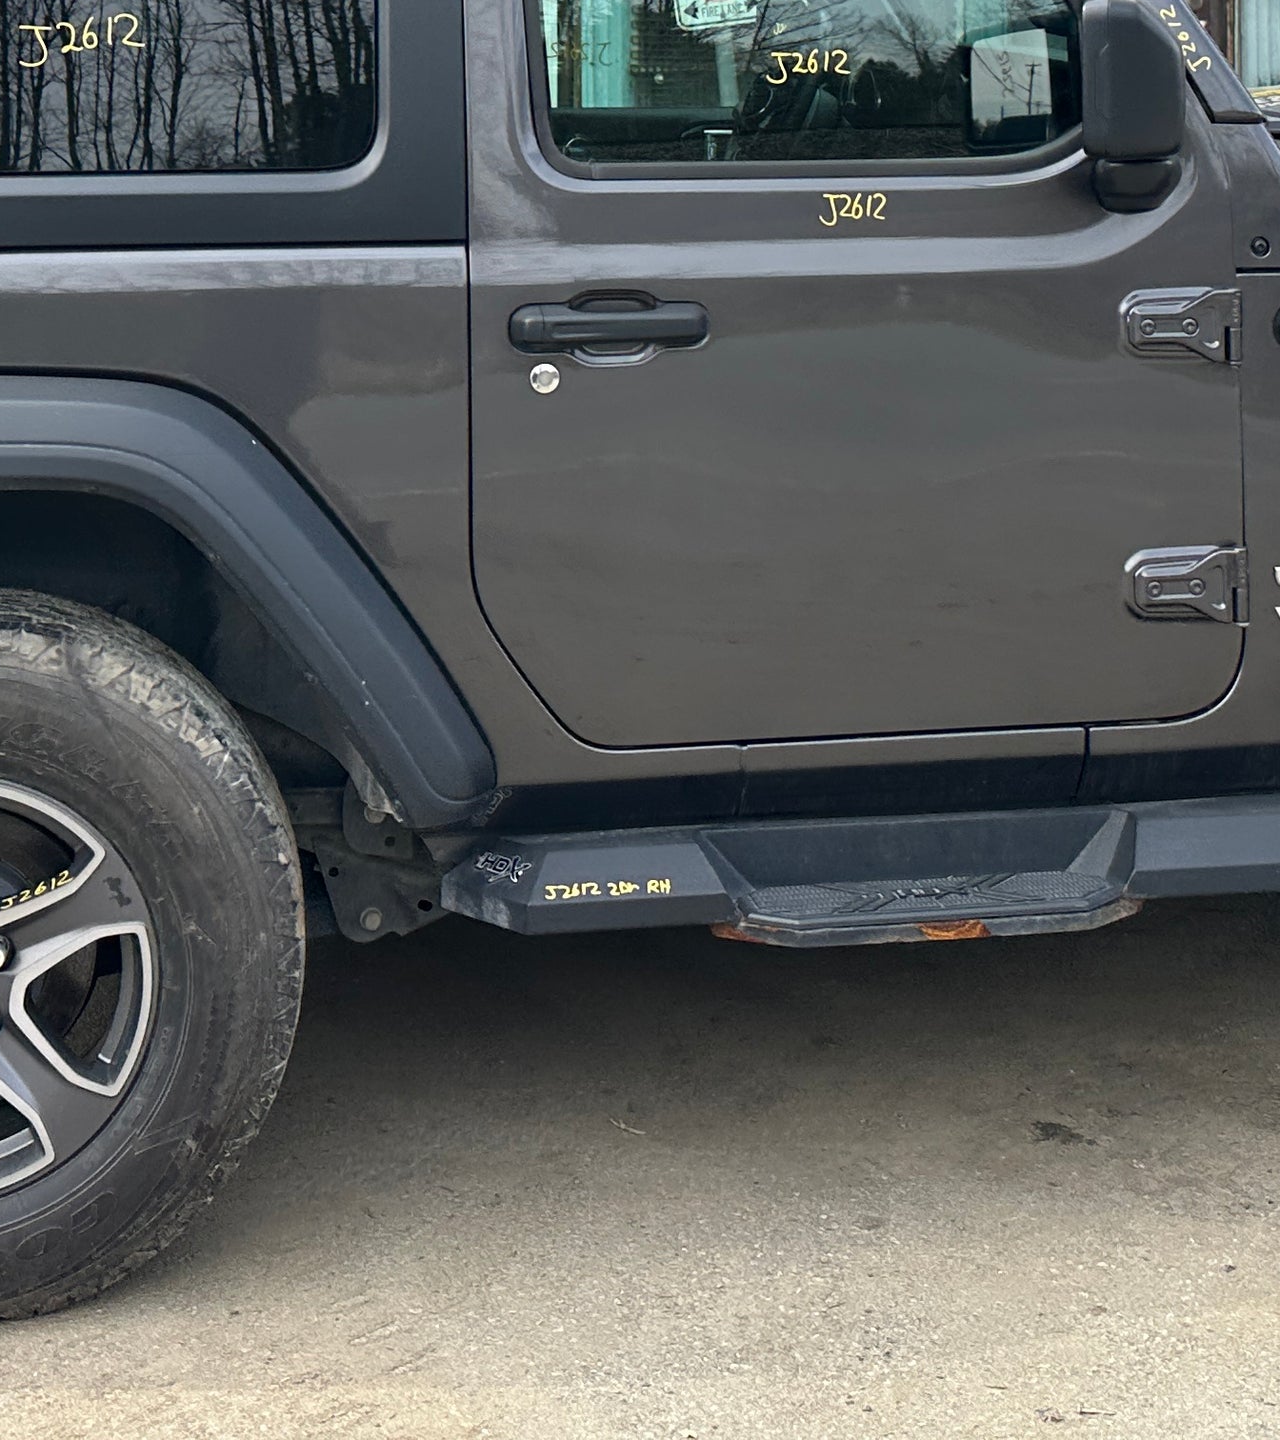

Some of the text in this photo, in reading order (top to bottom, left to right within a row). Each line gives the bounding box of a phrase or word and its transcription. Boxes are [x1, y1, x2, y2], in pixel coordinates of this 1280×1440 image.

[19, 13, 147, 68] J2612
[766, 48, 852, 85] J2612
[819, 192, 887, 227] J2612
[475, 851, 533, 884] HDX
[0, 869, 74, 910] J2612
[645, 878, 672, 894] RH
